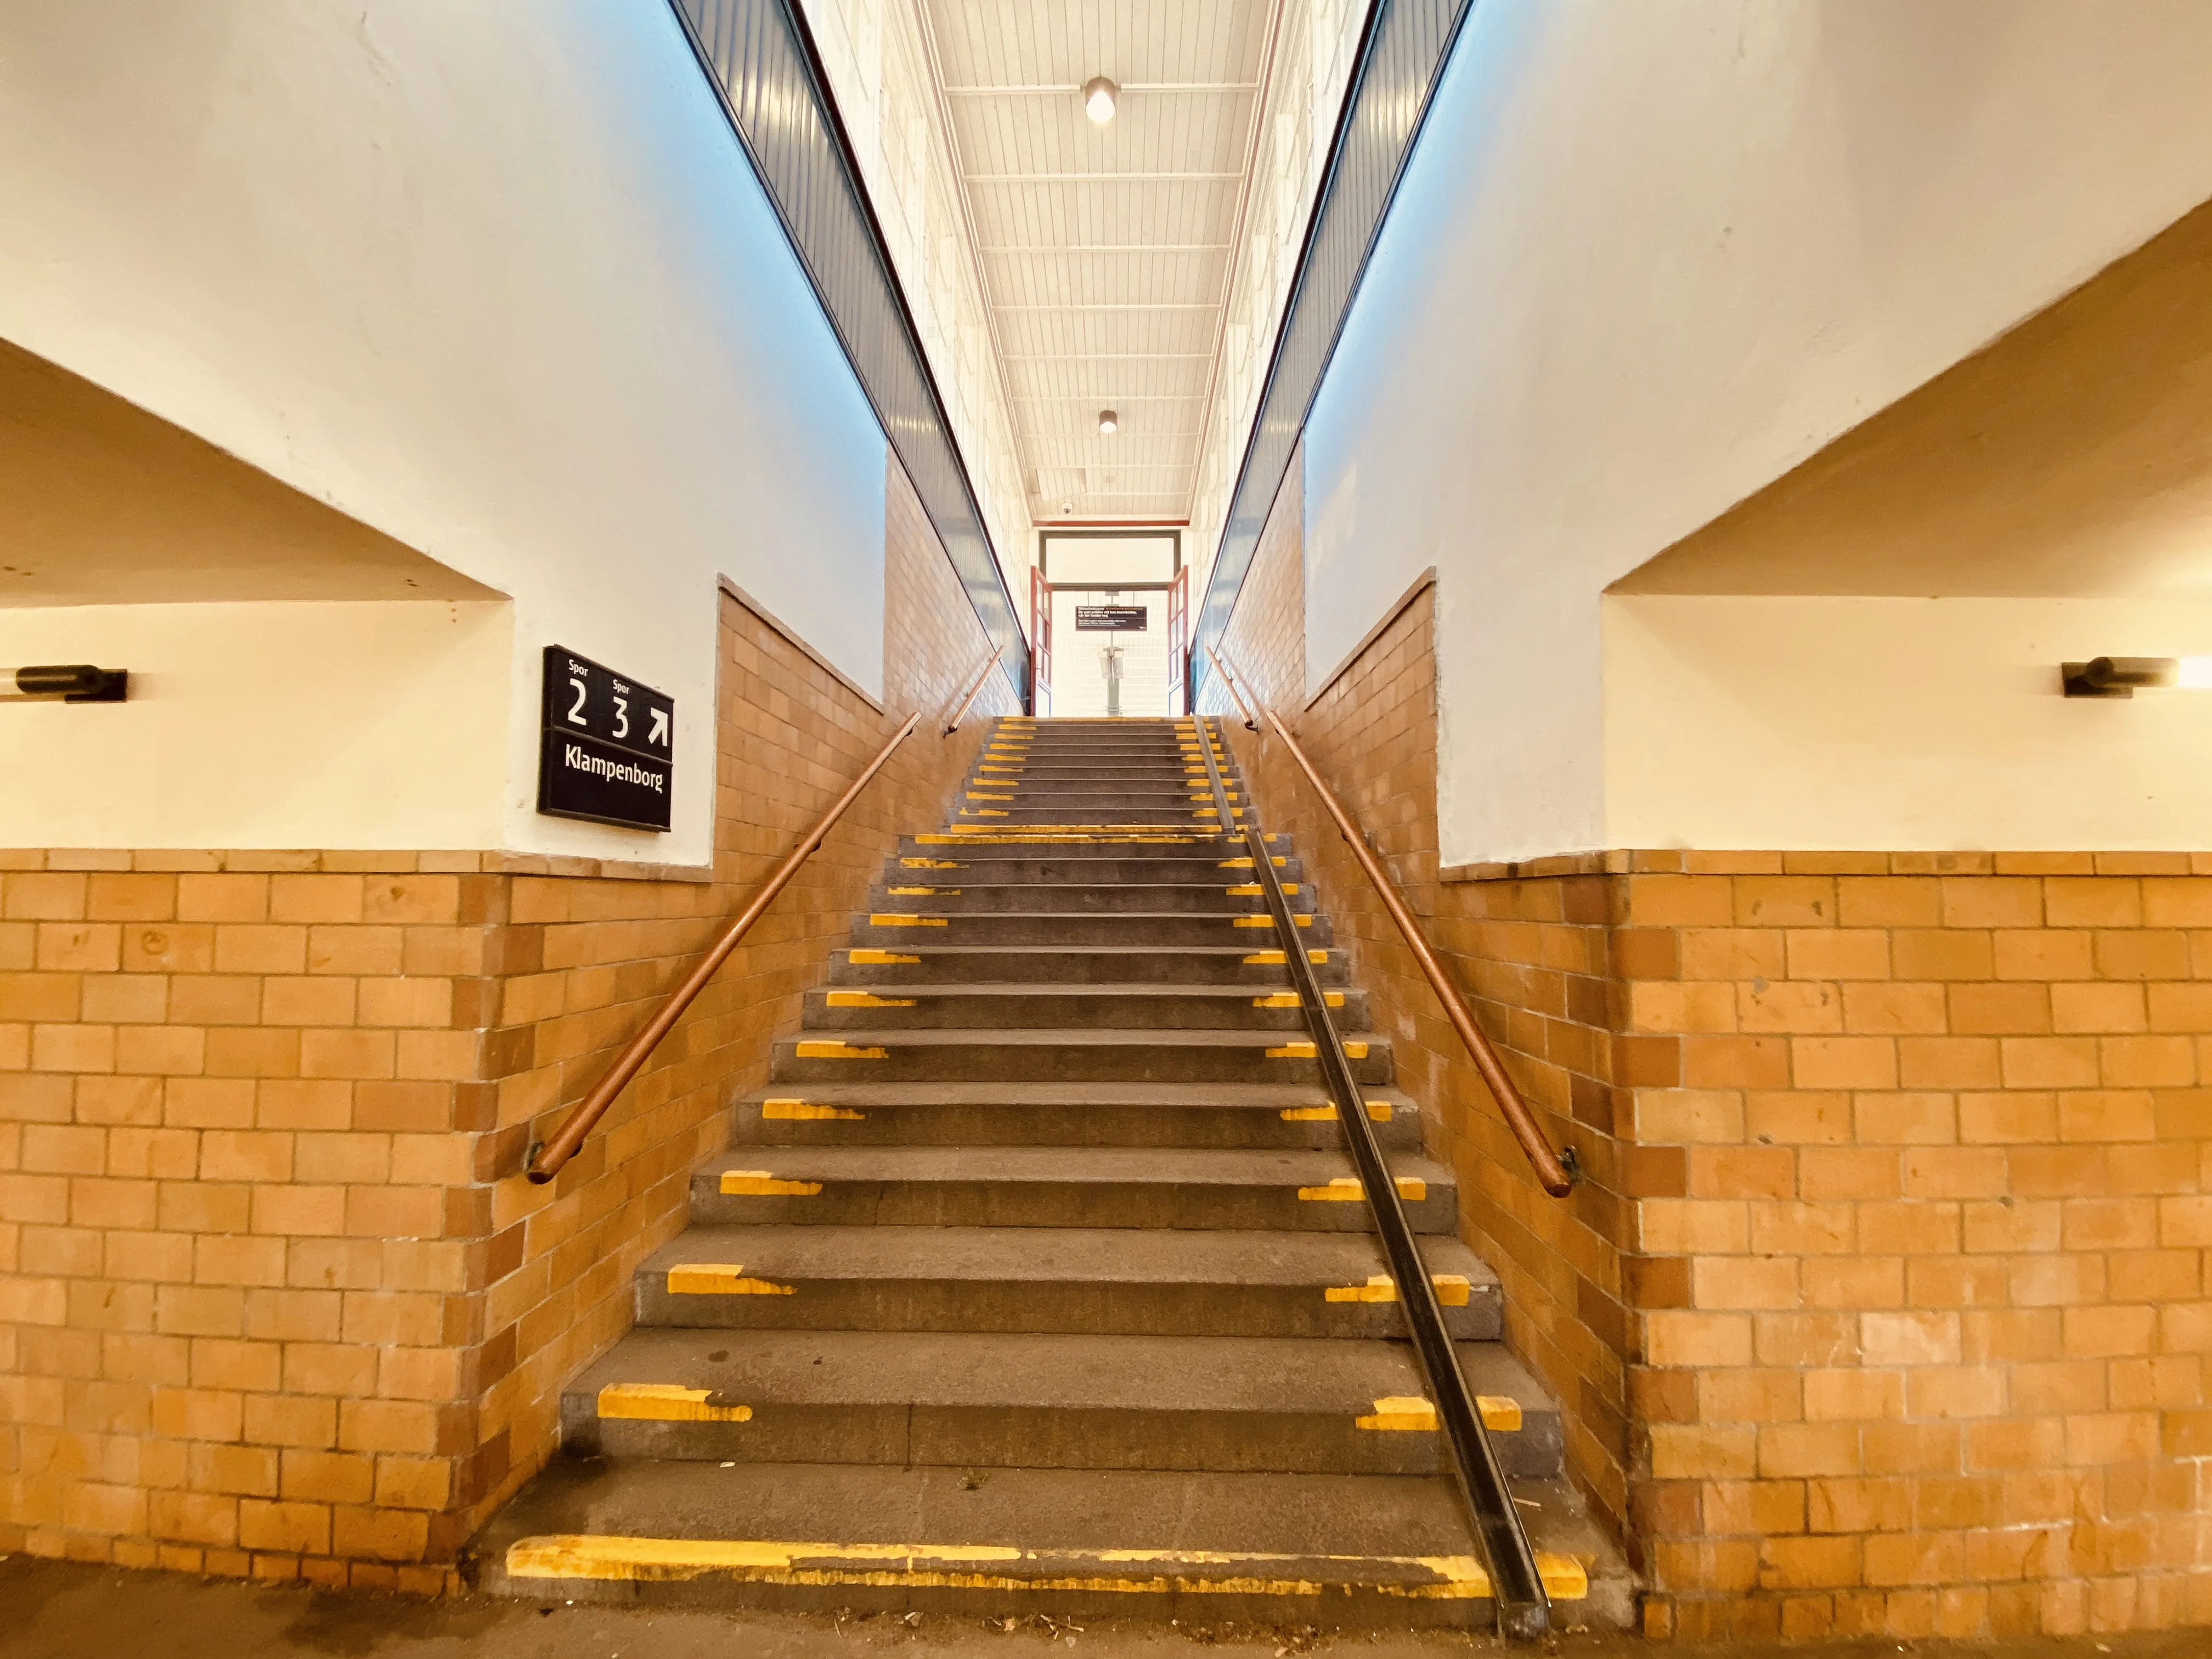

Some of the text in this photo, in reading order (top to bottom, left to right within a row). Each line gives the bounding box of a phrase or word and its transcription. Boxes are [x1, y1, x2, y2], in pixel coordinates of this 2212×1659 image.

[568, 659, 630, 695] Spor Spor
[567, 678, 629, 738] 2 3
[565, 744, 663, 794] Klampenborg
